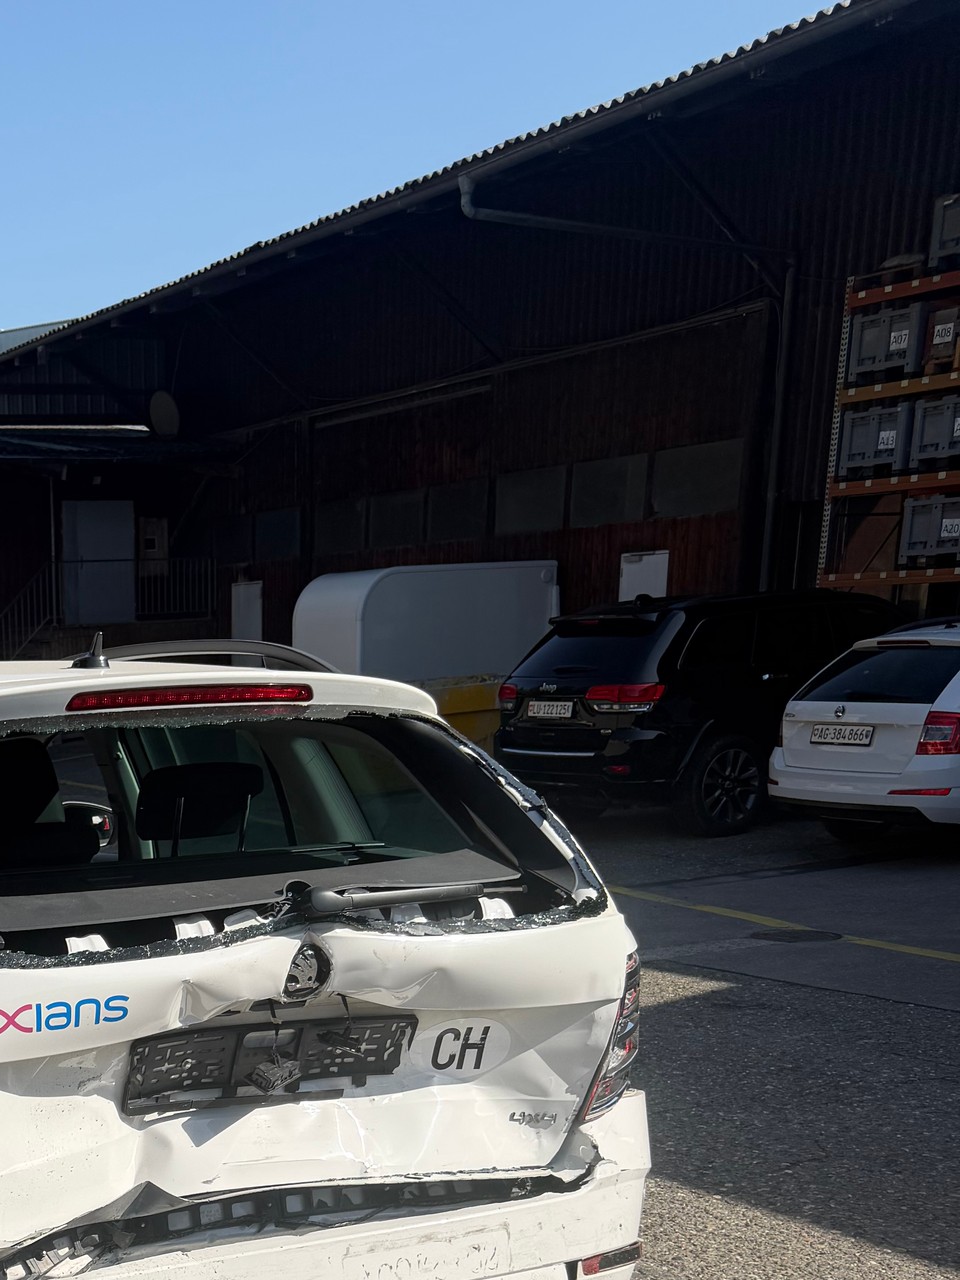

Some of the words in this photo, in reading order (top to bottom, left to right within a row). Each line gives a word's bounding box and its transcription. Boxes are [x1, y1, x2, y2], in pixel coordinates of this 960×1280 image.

[891, 333, 907, 345] A07
[935, 327, 951, 339] A08
[431, 1025, 490, 1070] CH
